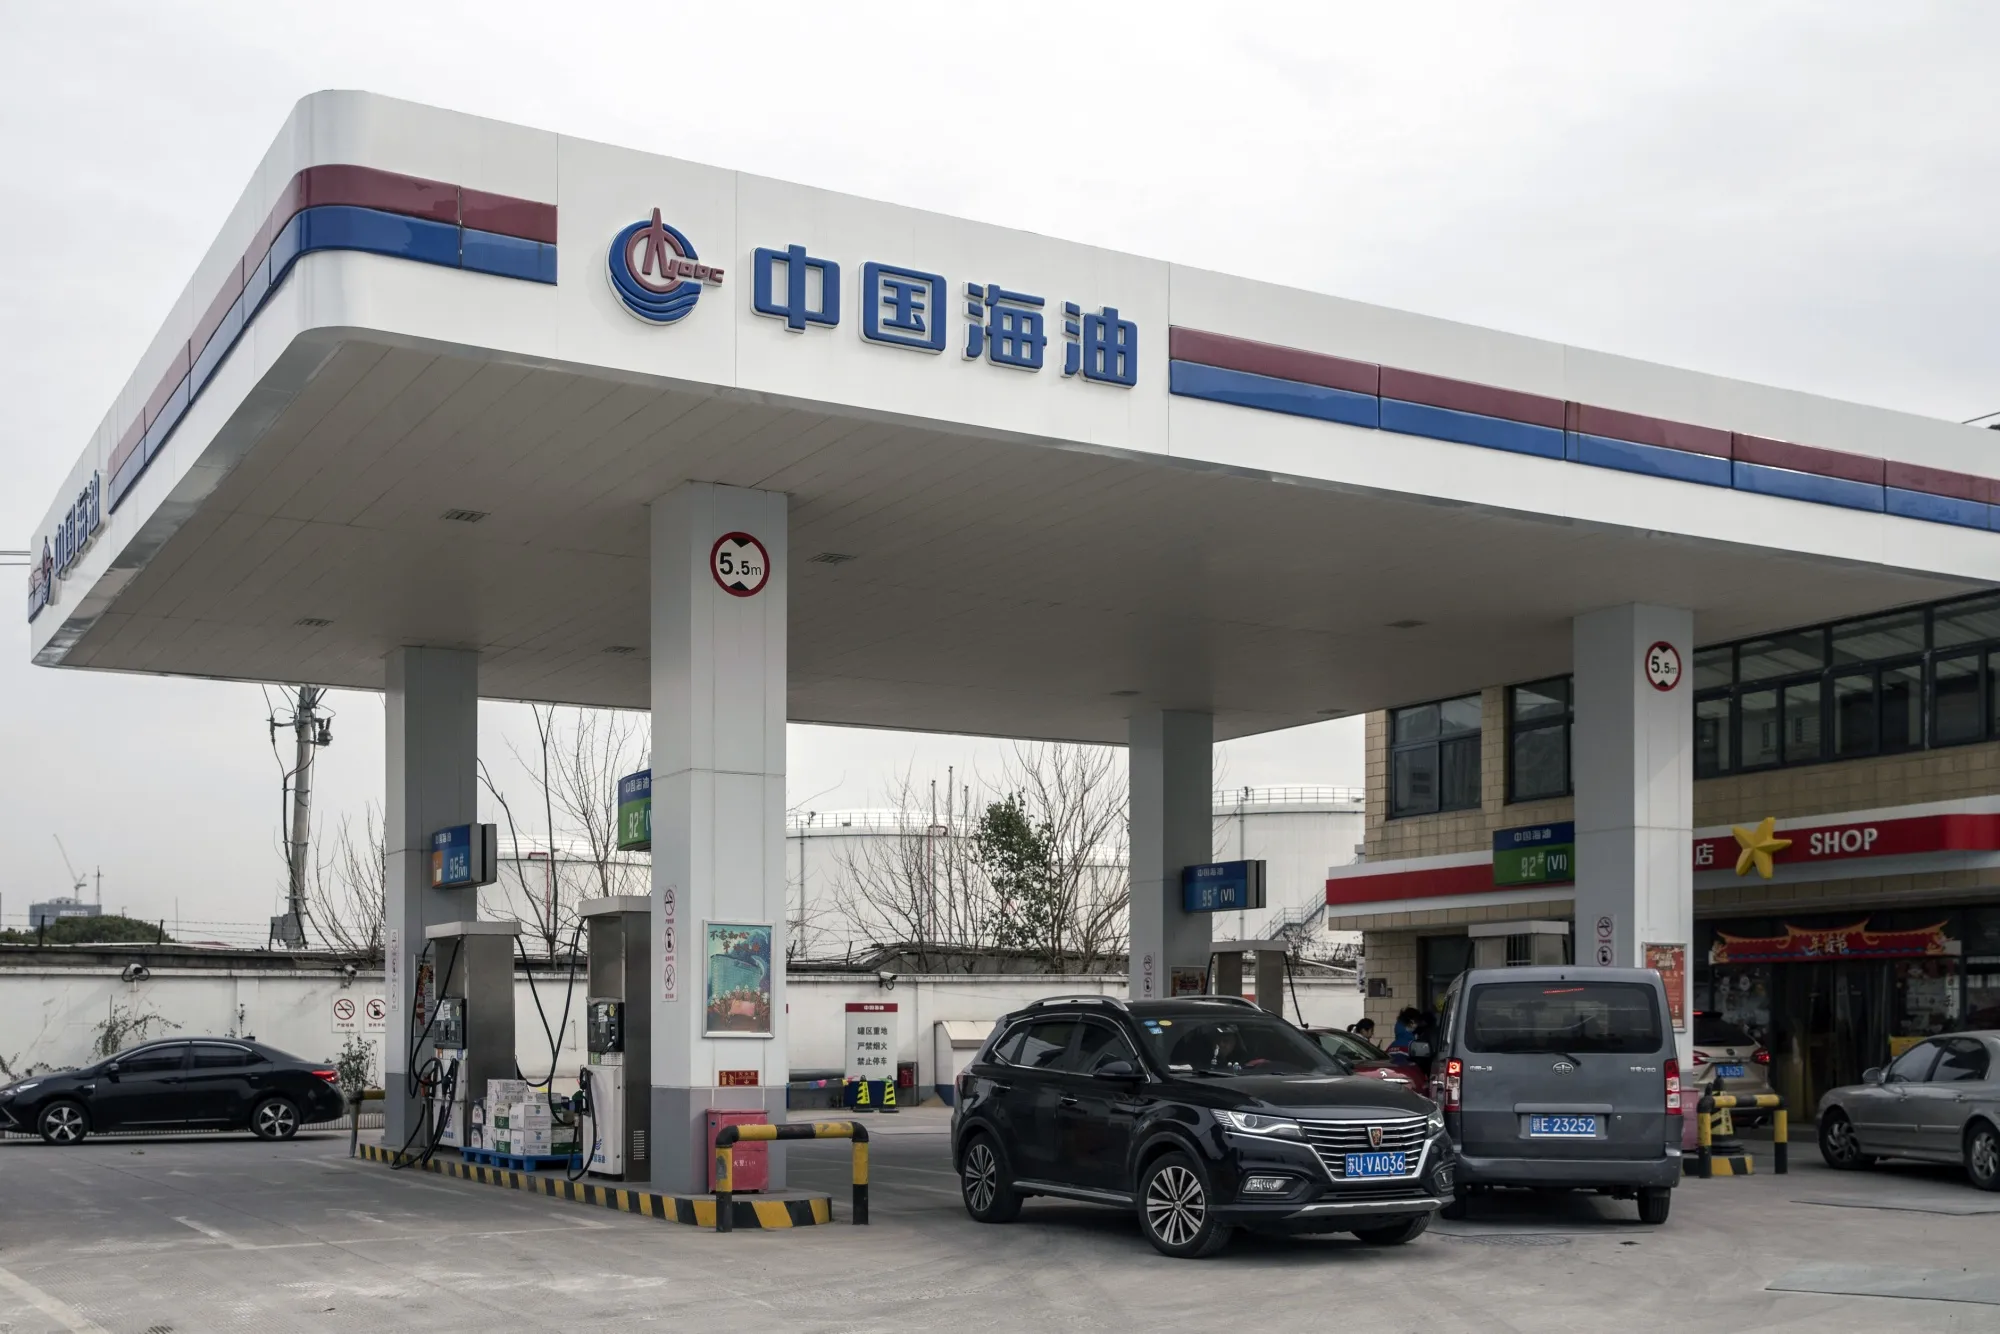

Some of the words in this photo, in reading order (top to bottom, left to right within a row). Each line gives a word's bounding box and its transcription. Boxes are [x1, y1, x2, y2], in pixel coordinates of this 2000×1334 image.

[750, 243, 1138, 389] 中国海油
[720, 552, 762, 576] 5.5m
[1651, 655, 1677, 674] 5.5m
[1810, 828, 1878, 855] SHOP
[1695, 843, 1714, 865] 店
[857, 1027, 888, 1035] 罐区重地
[857, 1042, 888, 1050] 严禁烟火
[857, 1057, 887, 1066] 禁止停车
